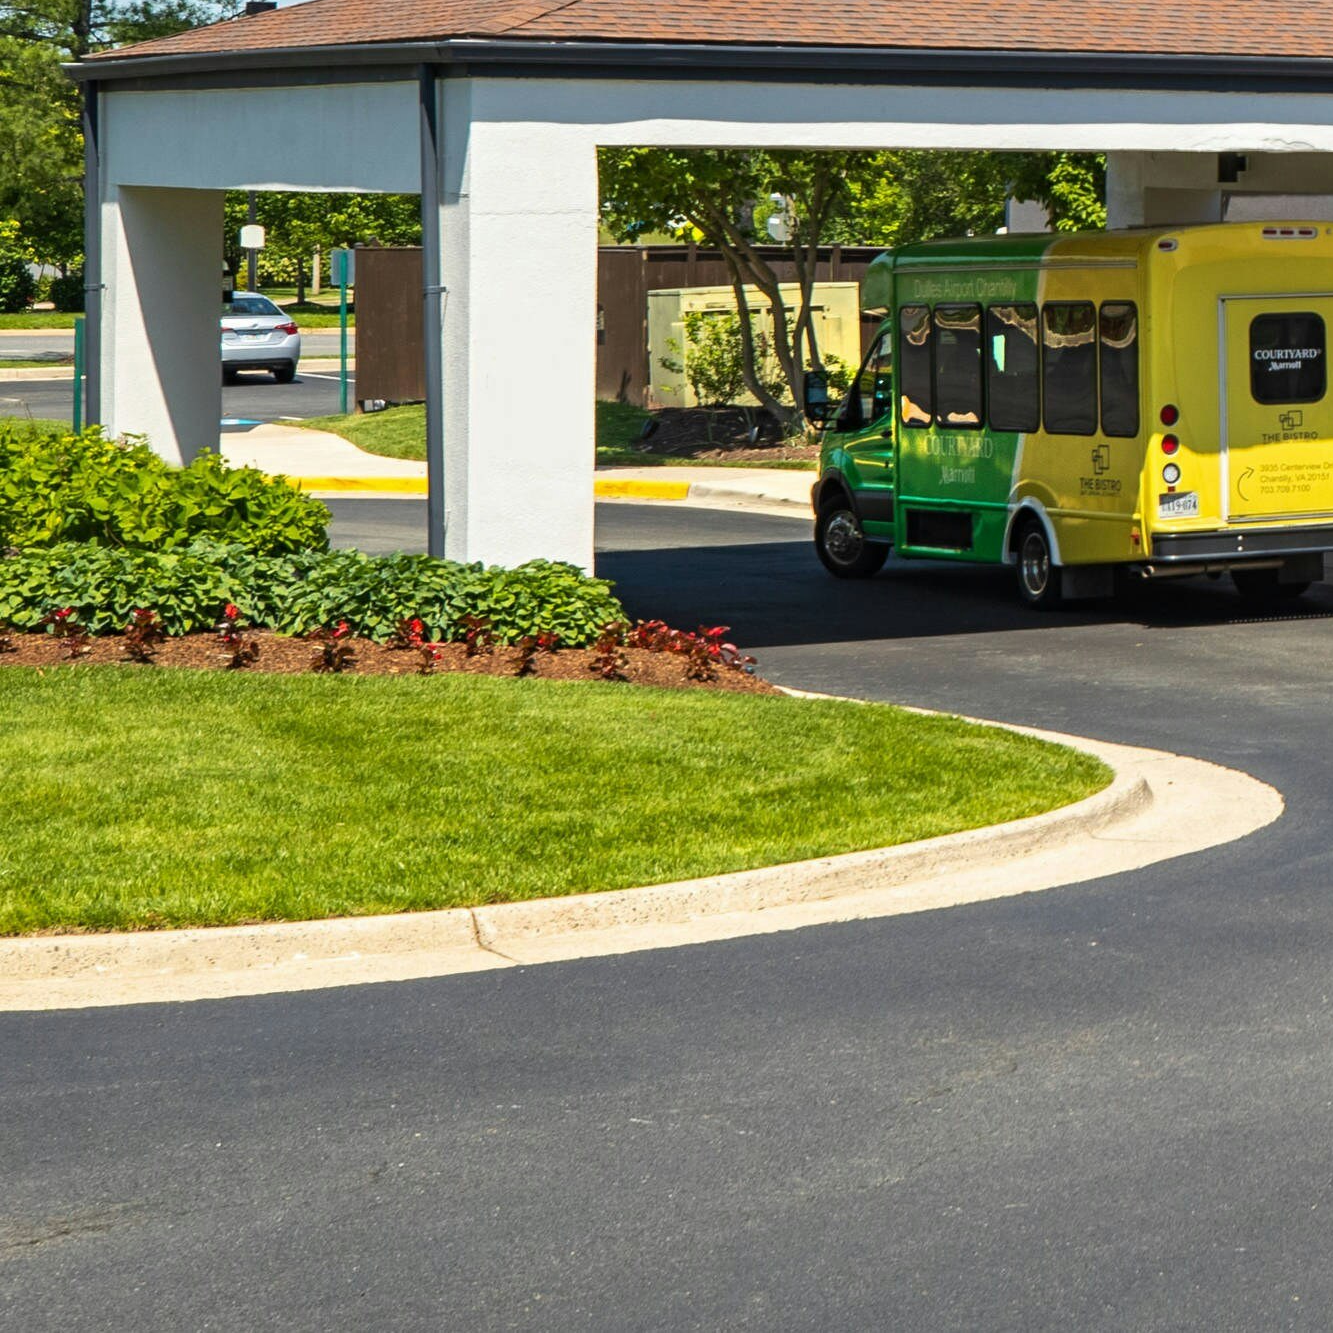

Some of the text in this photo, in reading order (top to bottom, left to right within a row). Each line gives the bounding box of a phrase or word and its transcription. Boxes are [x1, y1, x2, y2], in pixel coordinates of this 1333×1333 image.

[1254, 348, 1318, 360] COURTYARD
[1268, 360, 1302, 372] Marriott
[1262, 431, 1318, 443] THE BISTRO
[924, 434, 993, 458] COURTYARD
[939, 465, 976, 485] Marriott
